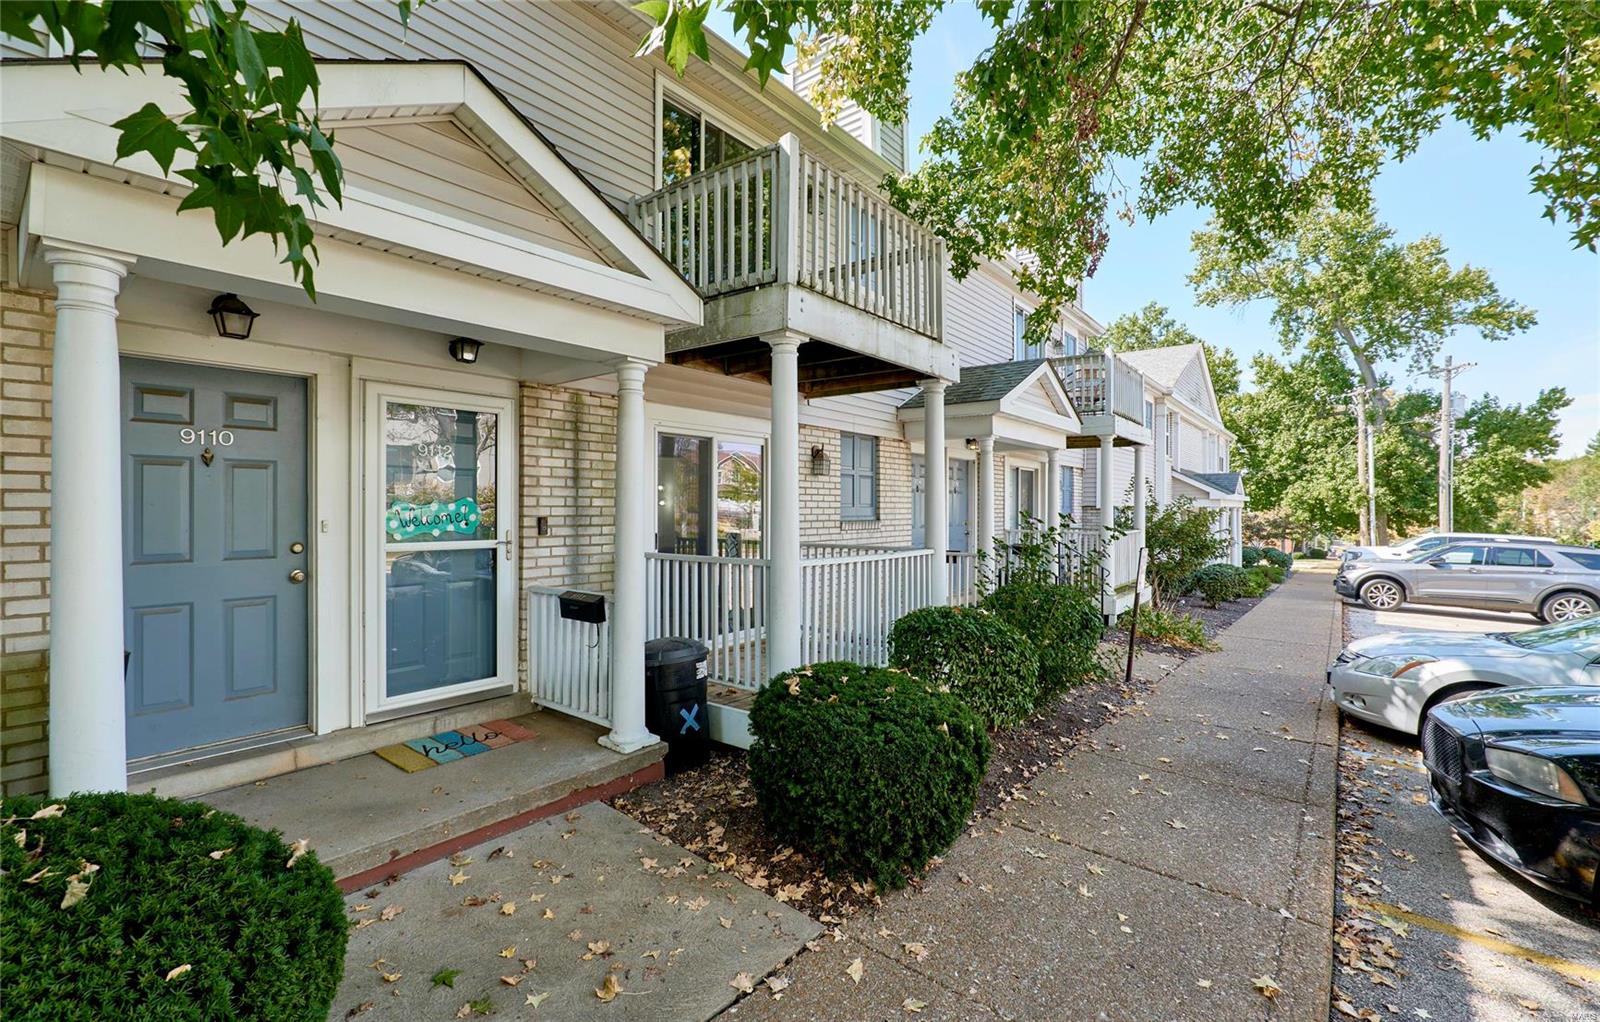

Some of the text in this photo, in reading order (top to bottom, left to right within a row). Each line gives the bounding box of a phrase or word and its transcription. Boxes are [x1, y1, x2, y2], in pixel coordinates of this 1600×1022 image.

[180, 427, 234, 446] 9110
[418, 443, 453, 457] 9112
[395, 504, 469, 528] Welcome!
[422, 731, 503, 757] hello
